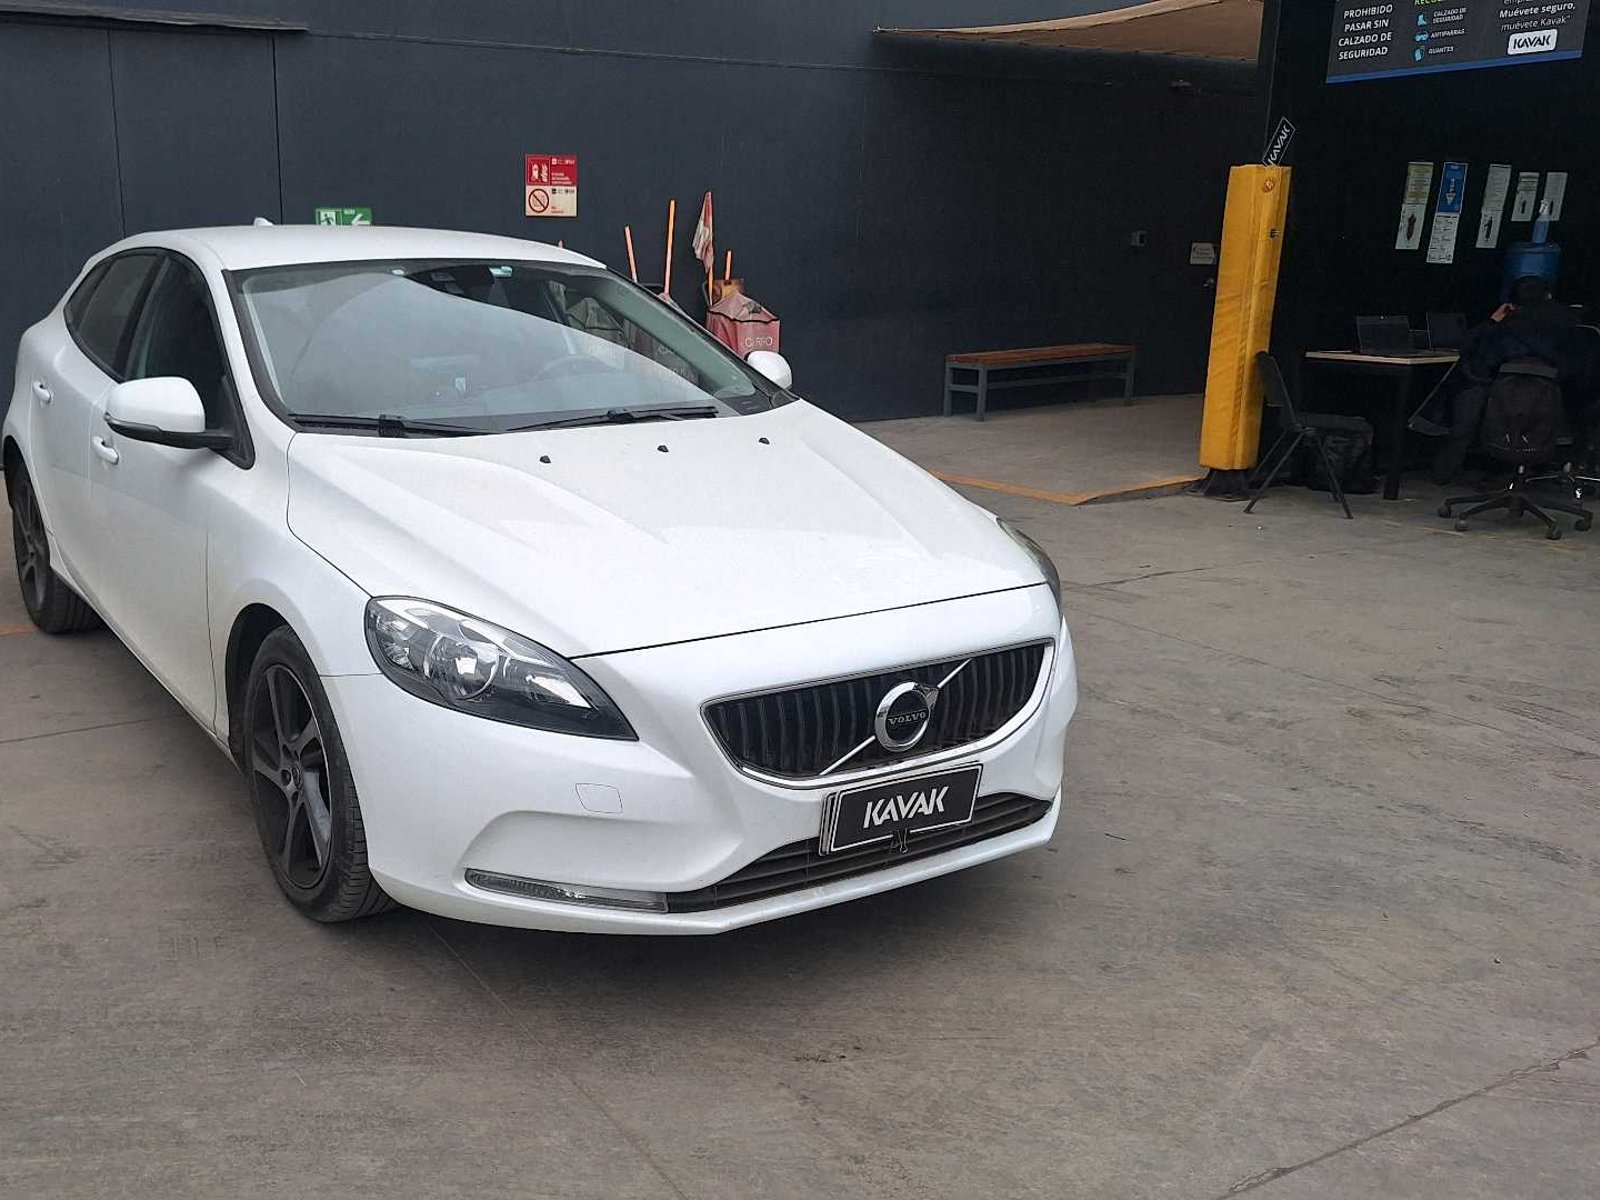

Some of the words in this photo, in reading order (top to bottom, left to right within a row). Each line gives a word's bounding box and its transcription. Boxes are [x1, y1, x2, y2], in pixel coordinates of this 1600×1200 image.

[1343, 4, 1393, 19] PROHIBIDO
[1499, 6, 1540, 18] Muévete
[1540, 2, 1576, 14] seguro,
[1344, 20, 1372, 32] PASAR
[1373, 18, 1389, 29] SIN
[1501, 19, 1539, 32] muévete
[1338, 34, 1379, 46] CALZADO
[1380, 31, 1393, 42] DE
[1512, 34, 1551, 50] KAVAK
[1338, 46, 1388, 60] SEGURIDAD
[888, 711, 927, 726] VOLVO
[863, 786, 949, 829] KAVAK
